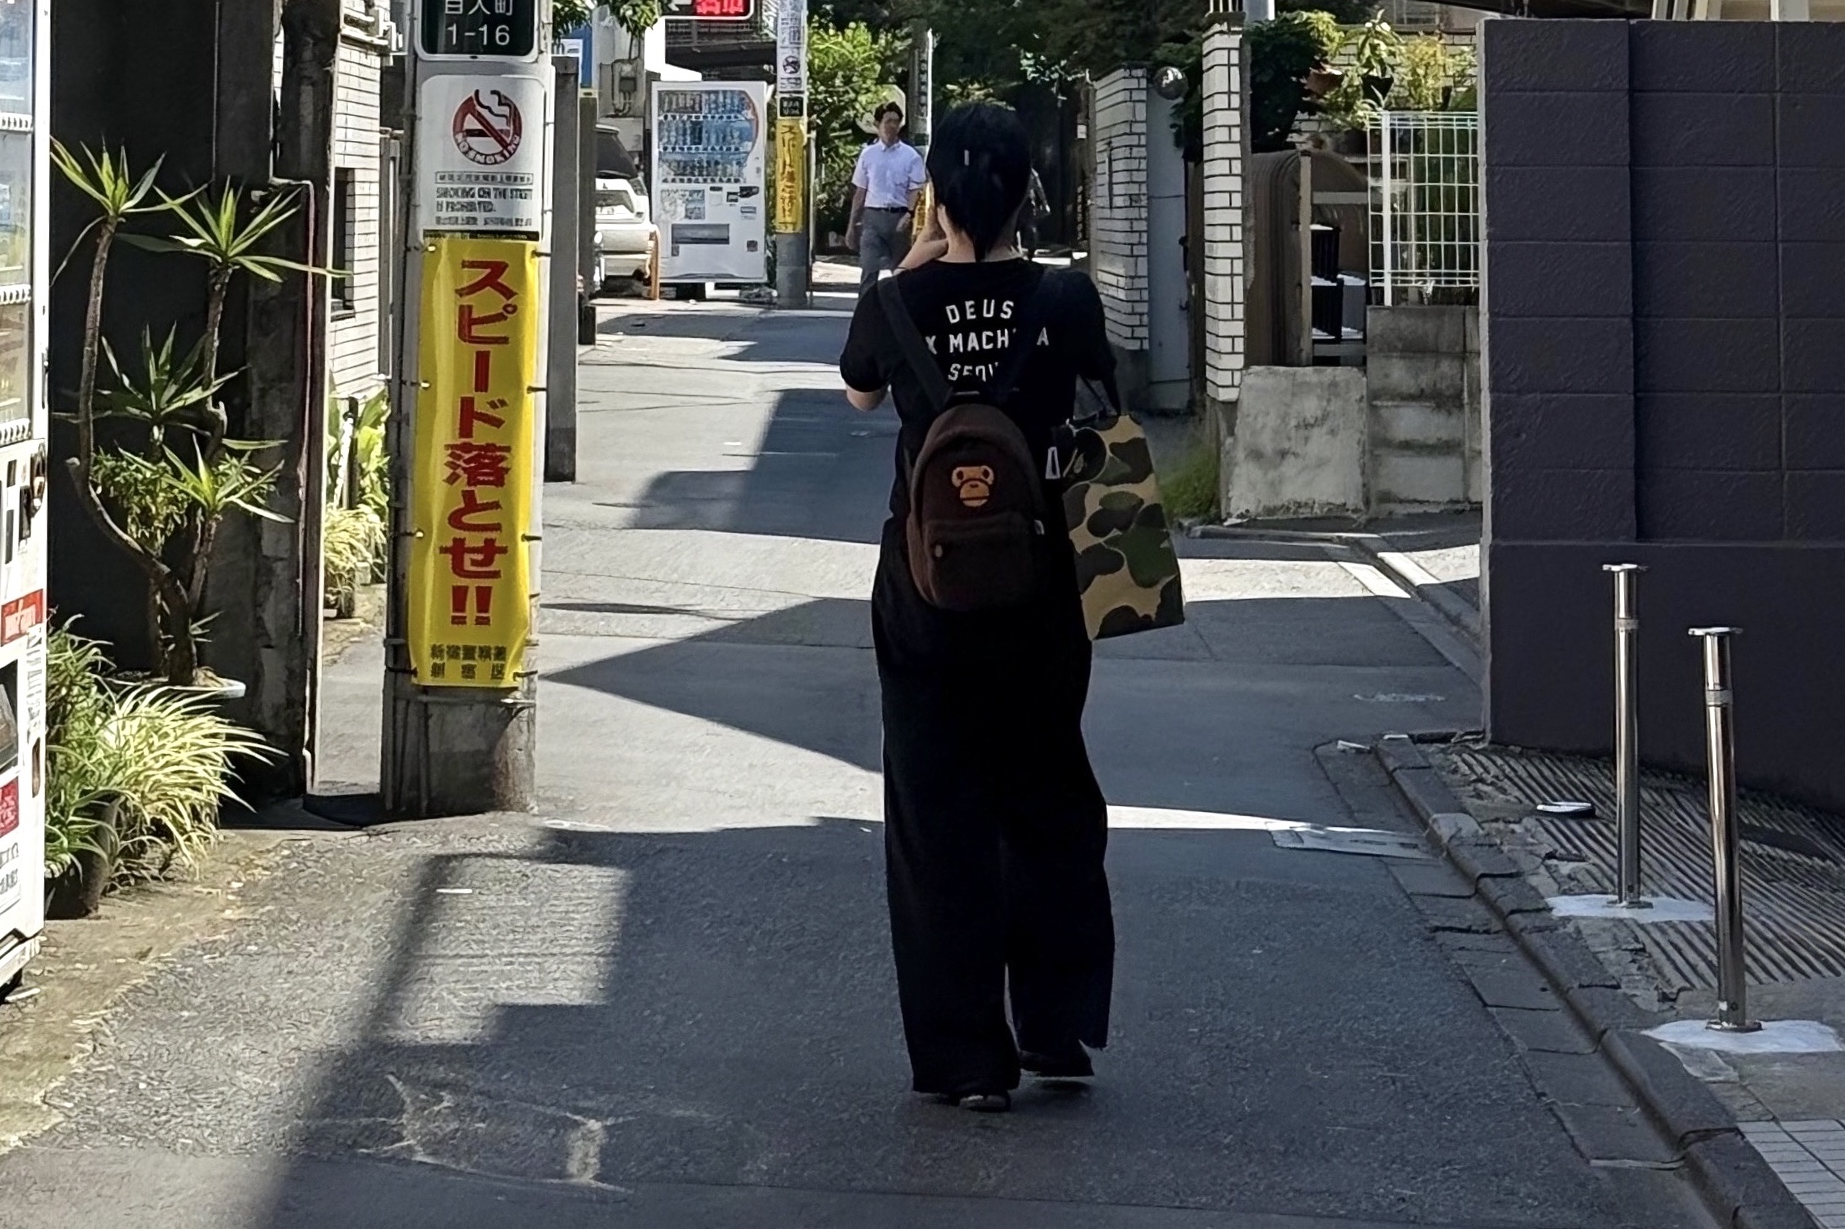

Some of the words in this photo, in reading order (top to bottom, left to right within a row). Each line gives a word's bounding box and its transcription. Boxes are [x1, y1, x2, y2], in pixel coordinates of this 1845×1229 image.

[446, 23, 510, 46] 1-16
[945, 298, 1014, 324] DEUS
[949, 327, 1049, 353] MACHA
[439, 259, 519, 627] スピード落とせ!!
